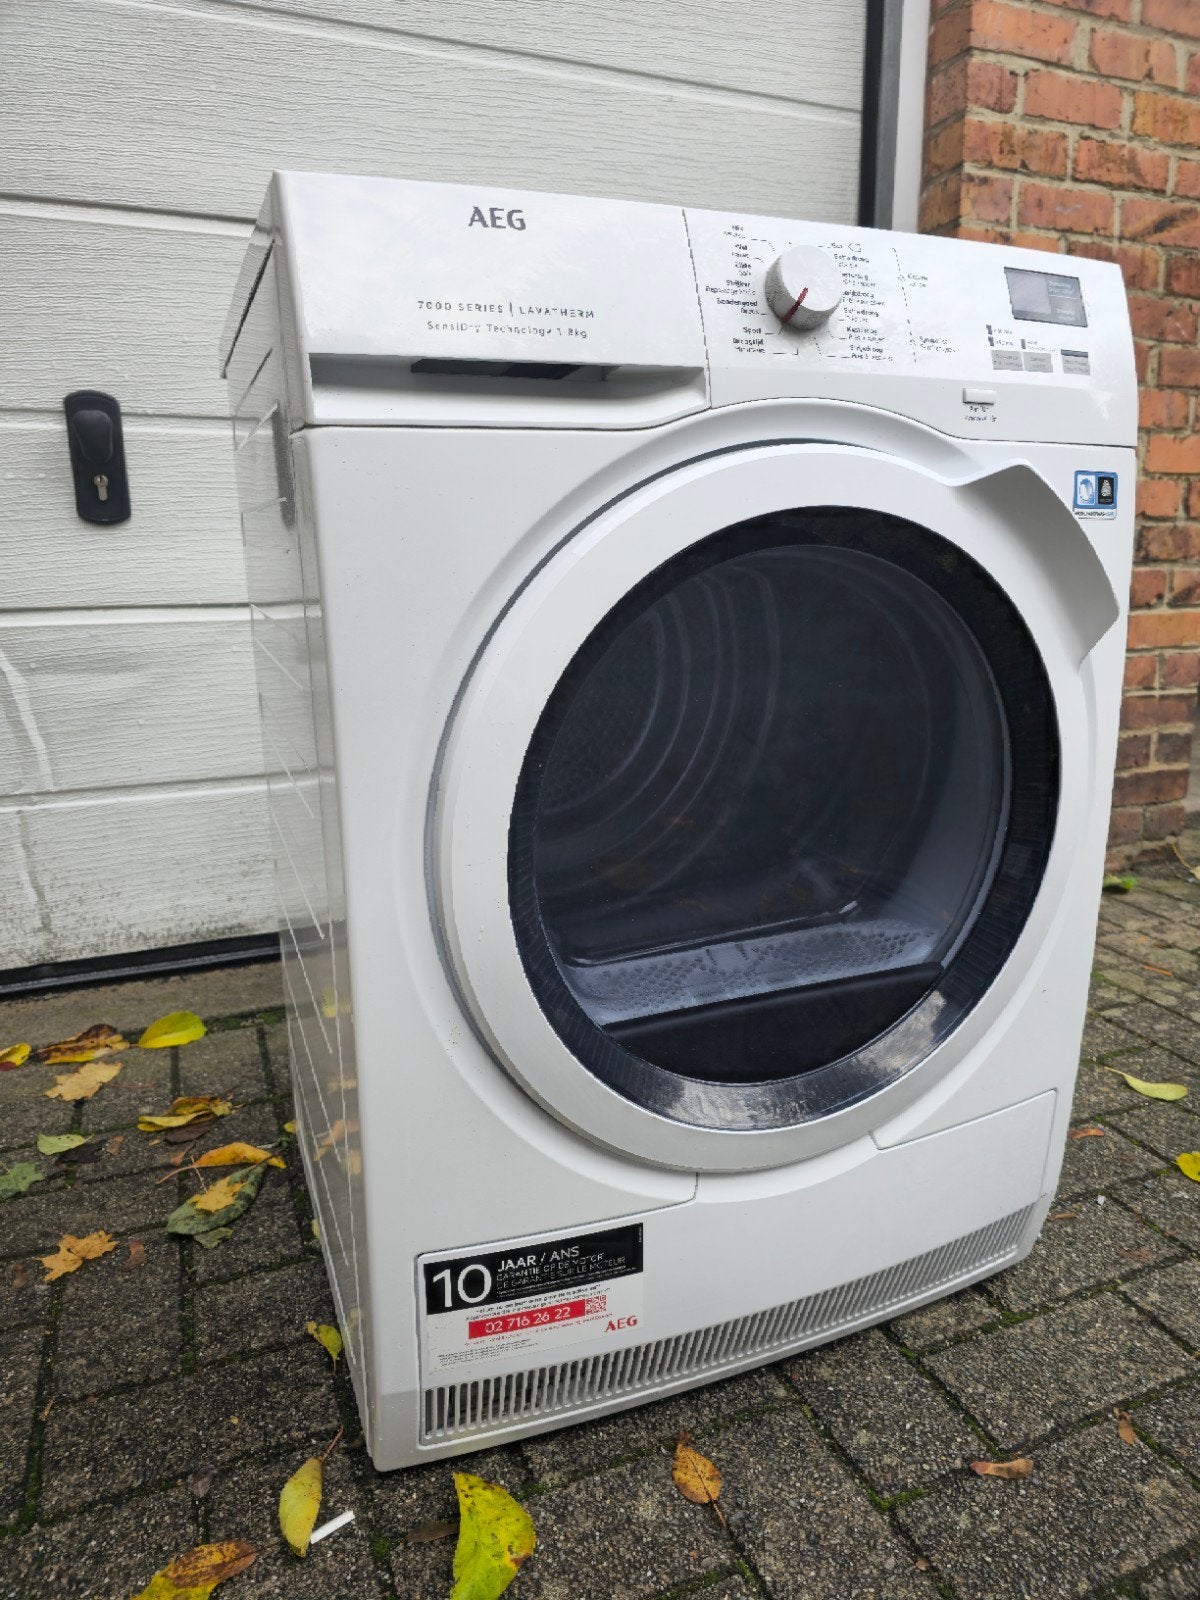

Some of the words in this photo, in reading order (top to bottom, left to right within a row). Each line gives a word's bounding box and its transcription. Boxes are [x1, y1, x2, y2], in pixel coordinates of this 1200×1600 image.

[468, 206, 526, 231] AEG
[417, 300, 452, 311] 7000
[458, 303, 503, 313] SERIES
[518, 306, 594, 319] LAVATHERM
[496, 1266, 540, 1282] GARANTIE
[558, 1260, 569, 1269] DE
[572, 1252, 605, 1266] MOTOR
[497, 1254, 537, 1272] JAAR
[549, 1245, 580, 1262] ANS
[511, 1272, 556, 1287] GARANTIE
[576, 1265, 588, 1274] LE
[589, 1256, 626, 1271] MOTEUR
[432, 1263, 493, 1309] 10
[484, 1321, 503, 1334] 02
[506, 1315, 530, 1330] 716
[533, 1312, 550, 1325] 26
[554, 1306, 571, 1320] 22
[604, 1315, 638, 1333] AEG
